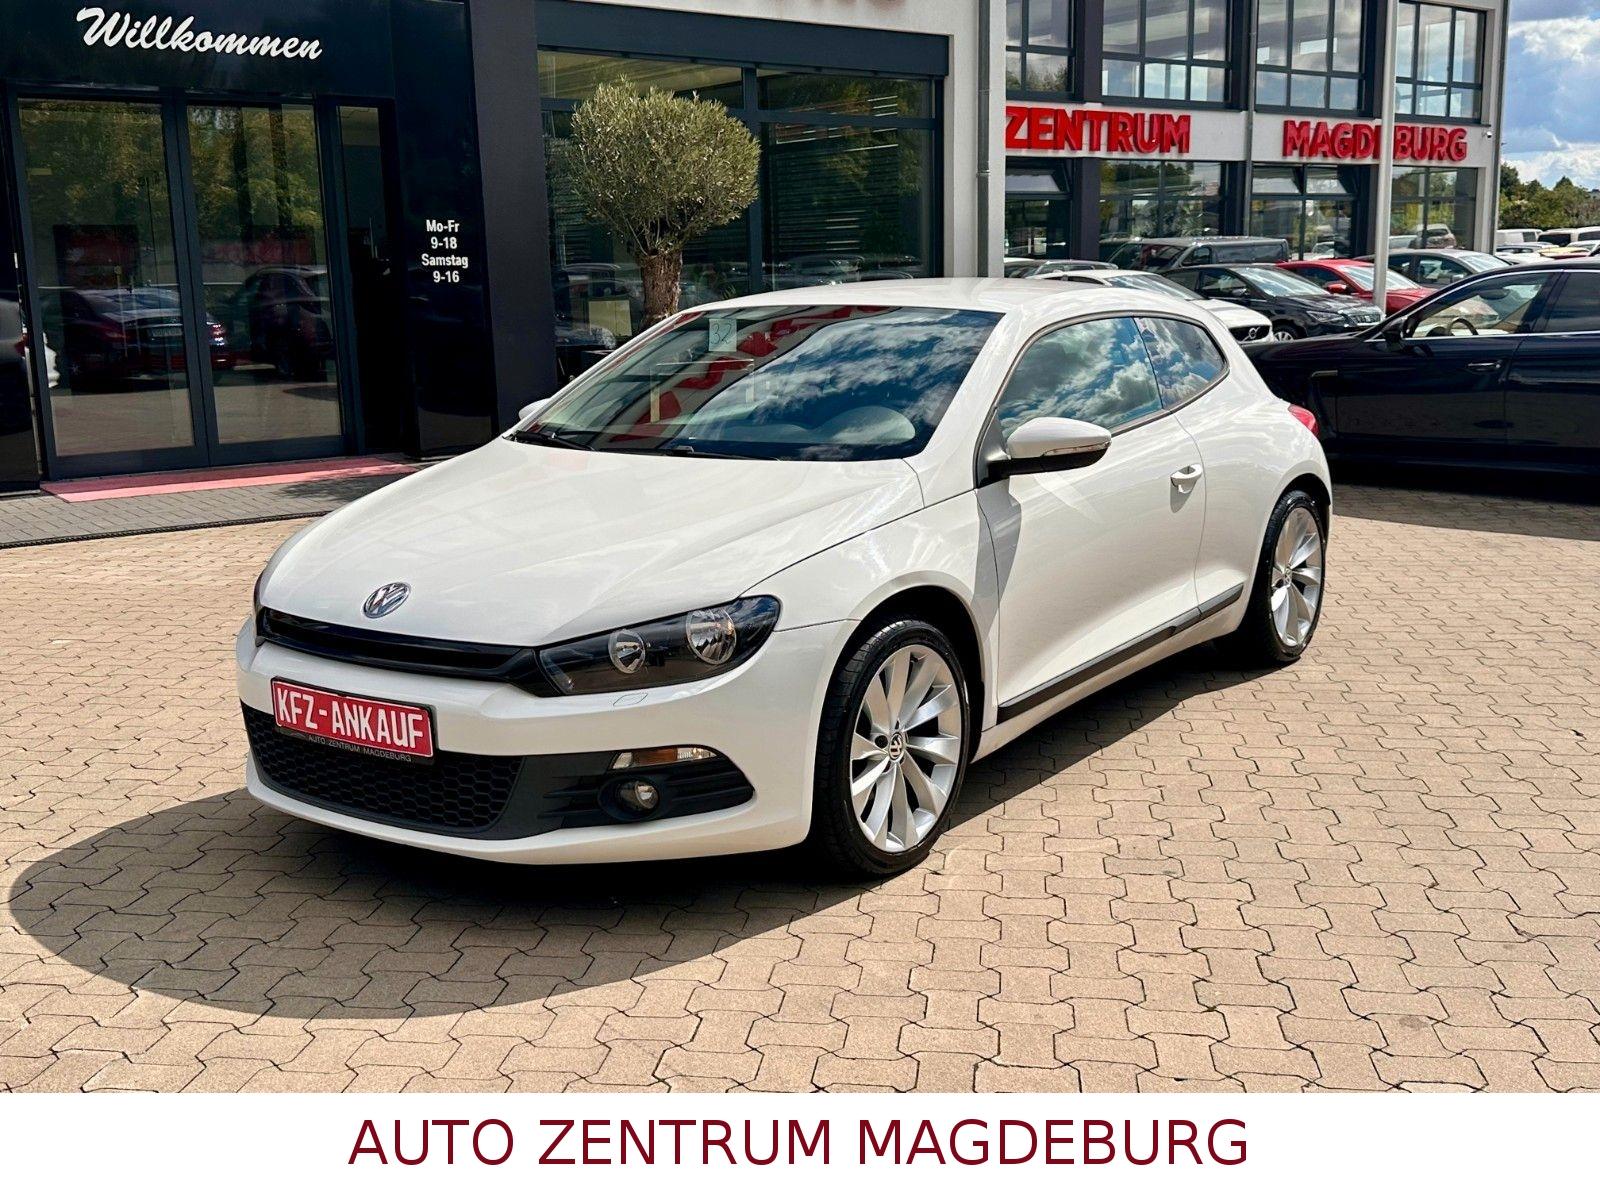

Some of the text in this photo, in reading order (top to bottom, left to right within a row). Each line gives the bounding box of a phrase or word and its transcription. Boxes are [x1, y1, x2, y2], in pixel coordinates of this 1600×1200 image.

[76, 7, 323, 60] Willkommen
[1005, 105, 1192, 155] ZENTRUM
[425, 219, 460, 233] Mo-Fr
[430, 236, 458, 249] 9-18
[421, 253, 469, 269] Samstag
[432, 270, 460, 283] 9-16
[276, 687, 424, 749] KFZ-ANKAUF
[308, 734, 412, 762] AUTO ZENTRUM MAGDEBURG
